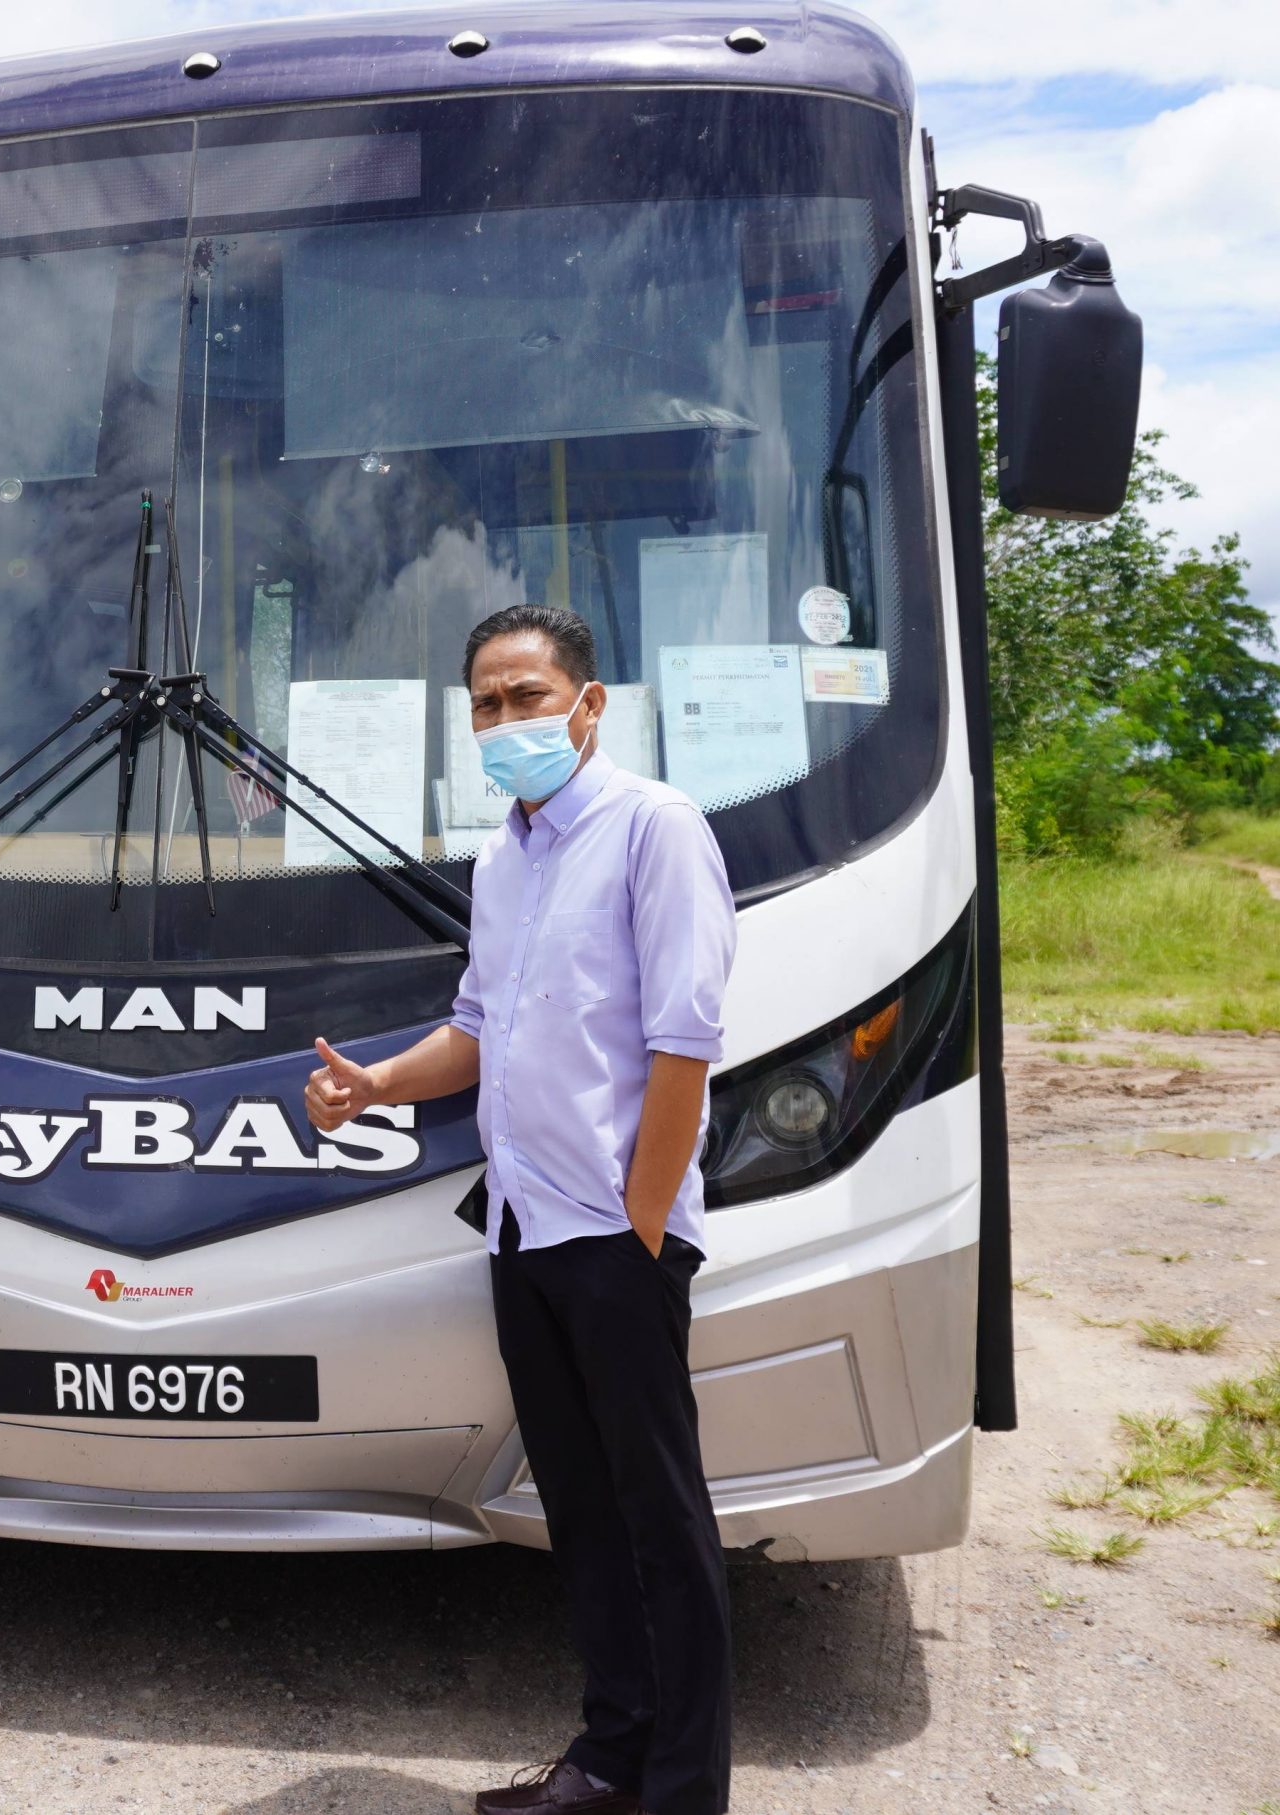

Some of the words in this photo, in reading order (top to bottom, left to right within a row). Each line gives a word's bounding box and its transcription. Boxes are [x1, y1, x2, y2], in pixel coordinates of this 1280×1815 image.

[684, 702, 701, 715] BB
[34, 986, 266, 1031] MAN
[122, 1286, 194, 1297] MARALINER
[55, 1361, 115, 1411] RN
[128, 1364, 246, 1414] 6976
